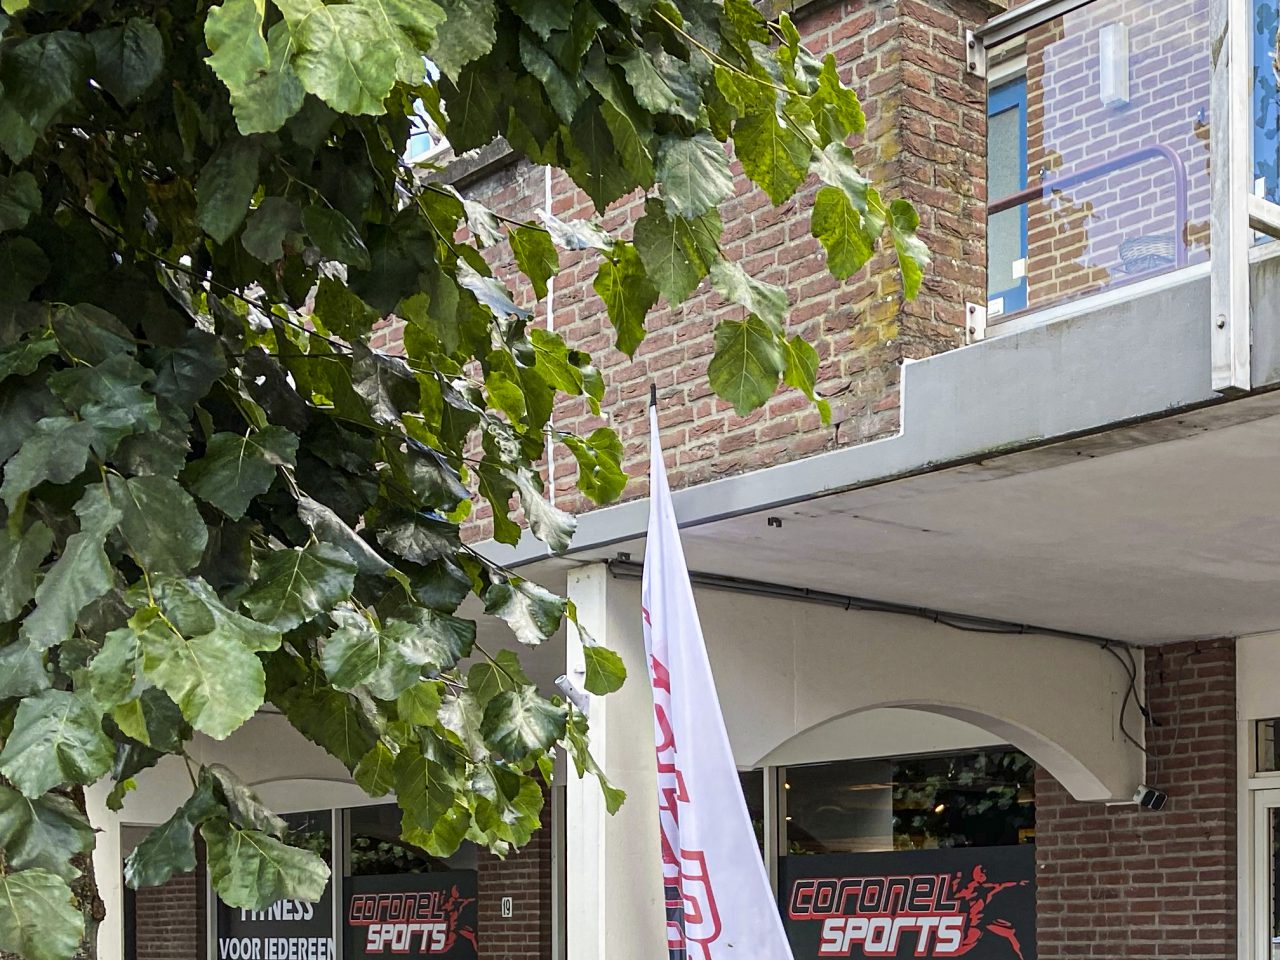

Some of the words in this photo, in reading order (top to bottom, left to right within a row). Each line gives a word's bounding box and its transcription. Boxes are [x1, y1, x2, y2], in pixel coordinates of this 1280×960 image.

[502, 898, 511, 916] 19
[219, 937, 261, 960] VOOR
[264, 937, 337, 960] IEDEREEN
